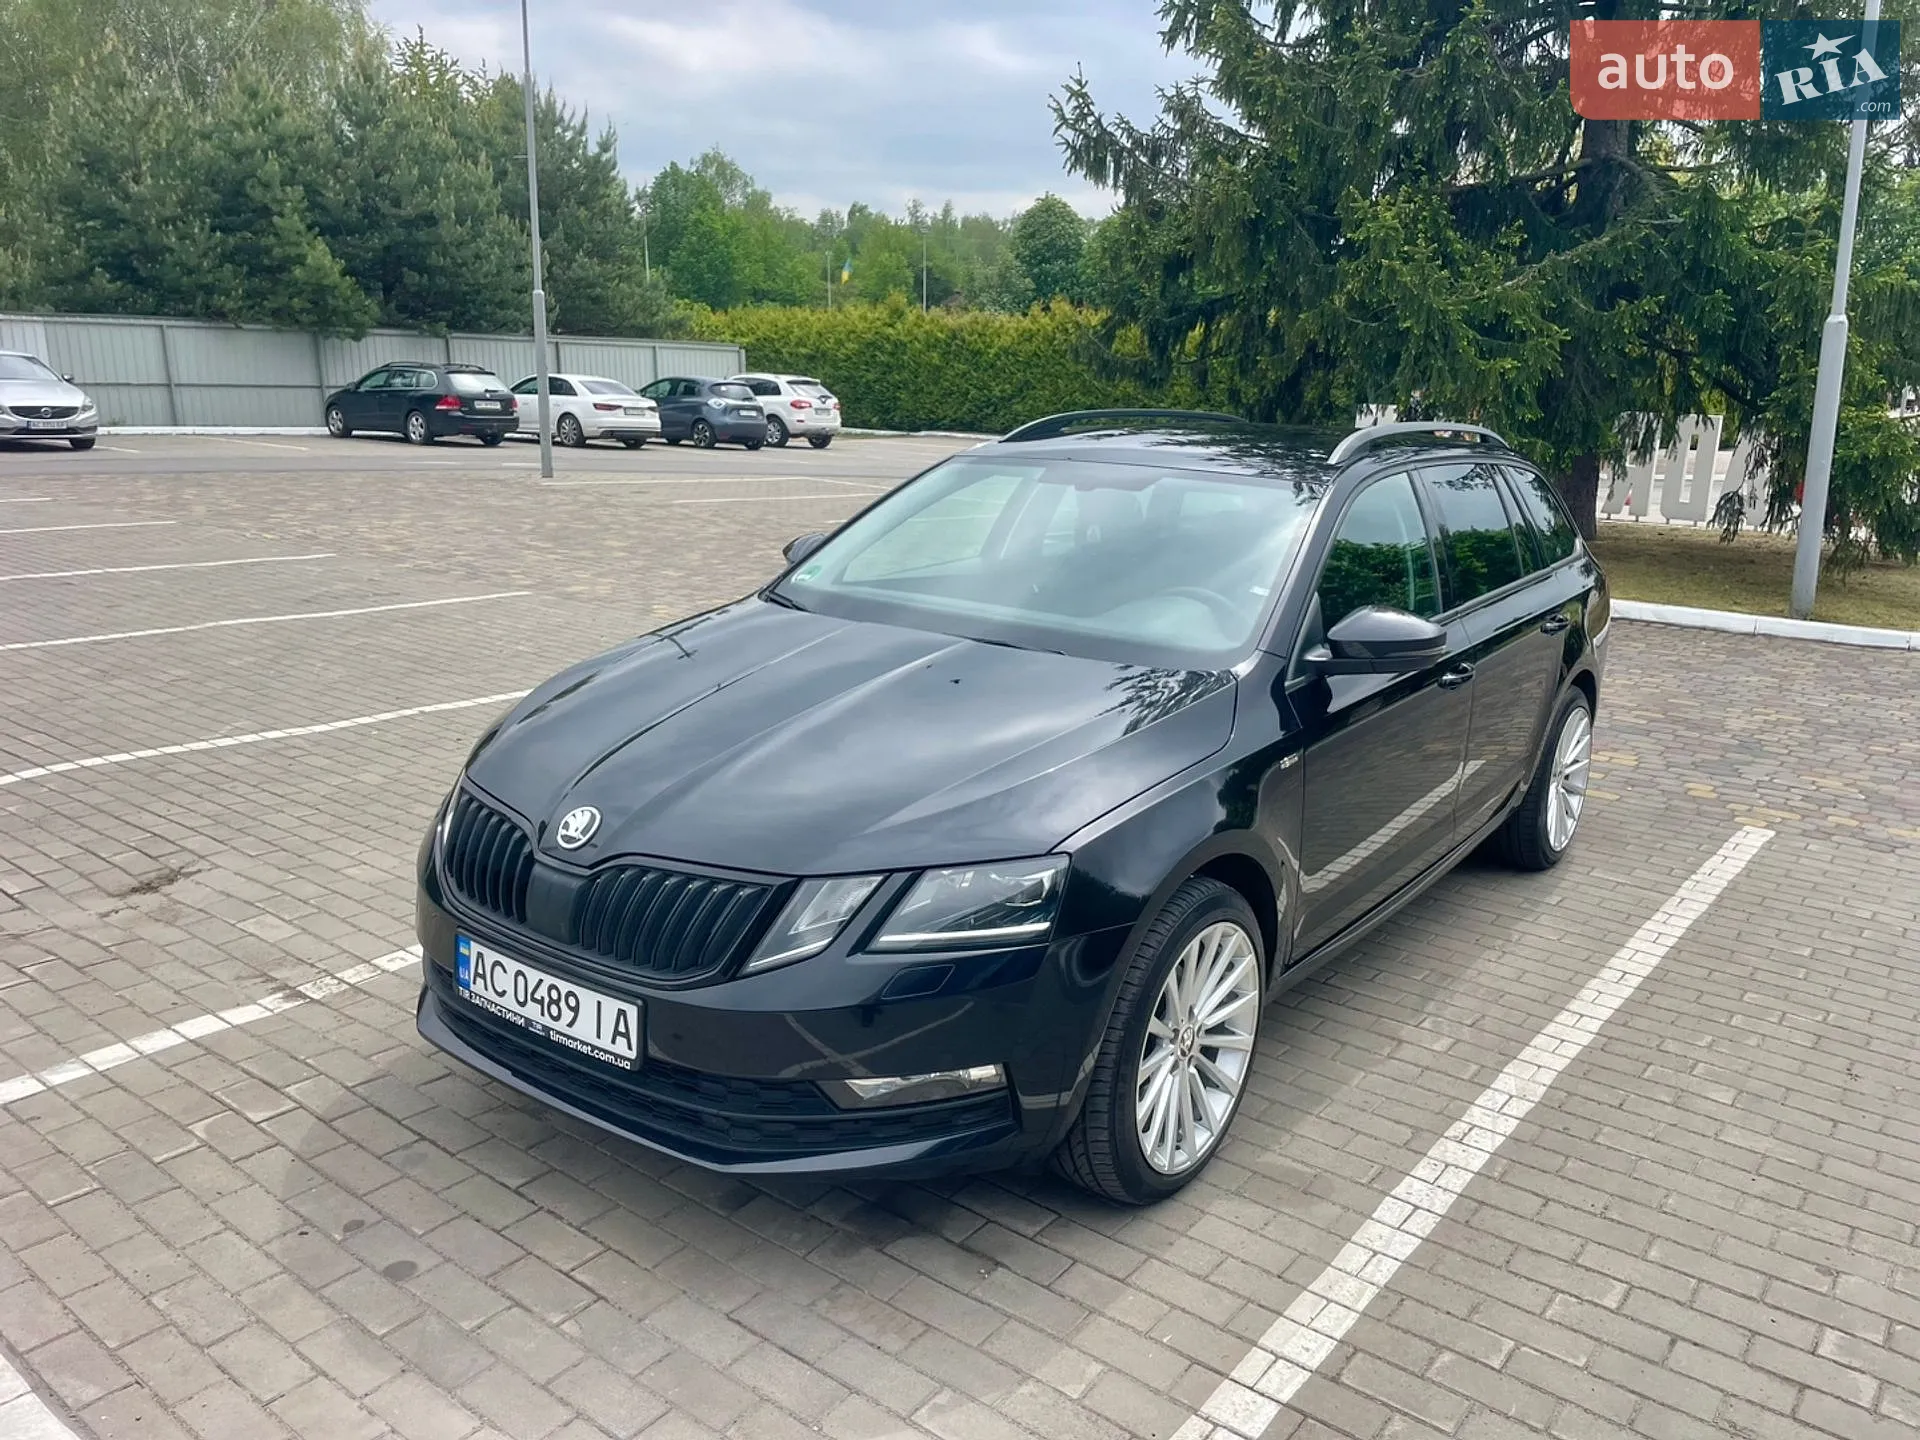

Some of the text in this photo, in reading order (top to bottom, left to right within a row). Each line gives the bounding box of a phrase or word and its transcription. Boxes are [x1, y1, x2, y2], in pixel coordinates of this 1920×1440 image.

[472, 951, 633, 1052] AC 0489 IA
[549, 1029, 631, 1070] tirmarket.com.ua
